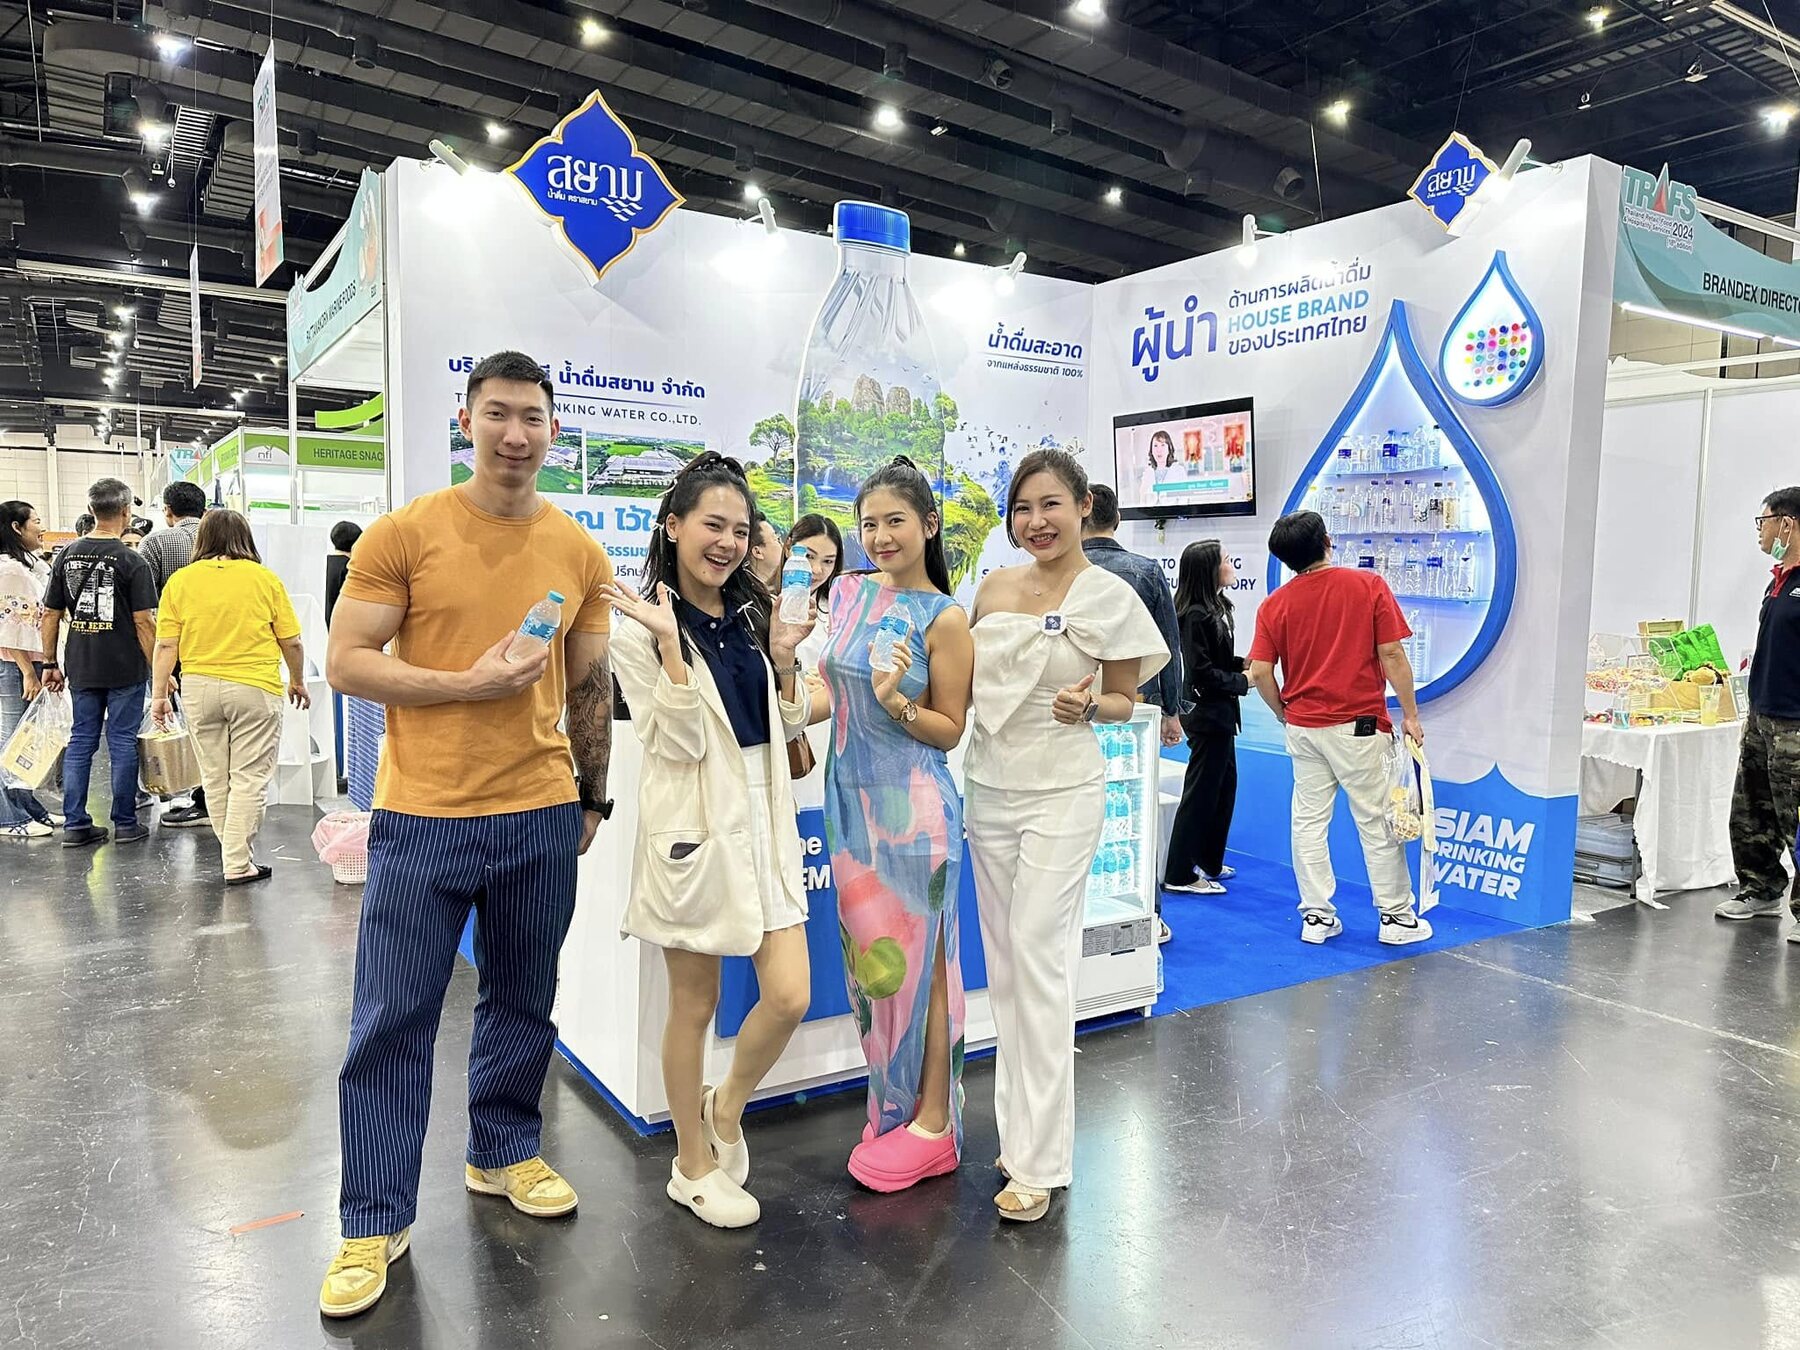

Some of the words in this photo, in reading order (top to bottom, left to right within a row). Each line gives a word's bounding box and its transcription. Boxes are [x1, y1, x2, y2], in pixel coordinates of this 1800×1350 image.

[547, 155, 643, 202] สยาม
[1427, 164, 1476, 192] สยาม
[1624, 162, 1697, 222] TRAFS
[1672, 222, 1694, 240] 2024
[1702, 272, 1759, 303] BRANDEX
[1228, 304, 1292, 334] HOUSE
[1297, 289, 1370, 320] BRAND
[988, 322, 1083, 359] น้ำดื่มสะอาด
[1132, 294, 1218, 382] ผู้นำ
[1228, 314, 1368, 356] ของประเทศไทย
[558, 360, 655, 393] น้ำดื่มสยาม
[661, 376, 706, 398] จำกัด
[986, 359, 1059, 376] จากแหล่งธรรมชาติ
[1060, 367, 1084, 378] 100%
[601, 406, 646, 421] WATER
[649, 411, 702, 426] CO.,LTD.
[313, 448, 358, 460] HERITAGE
[1434, 807, 1536, 855] SIAM
